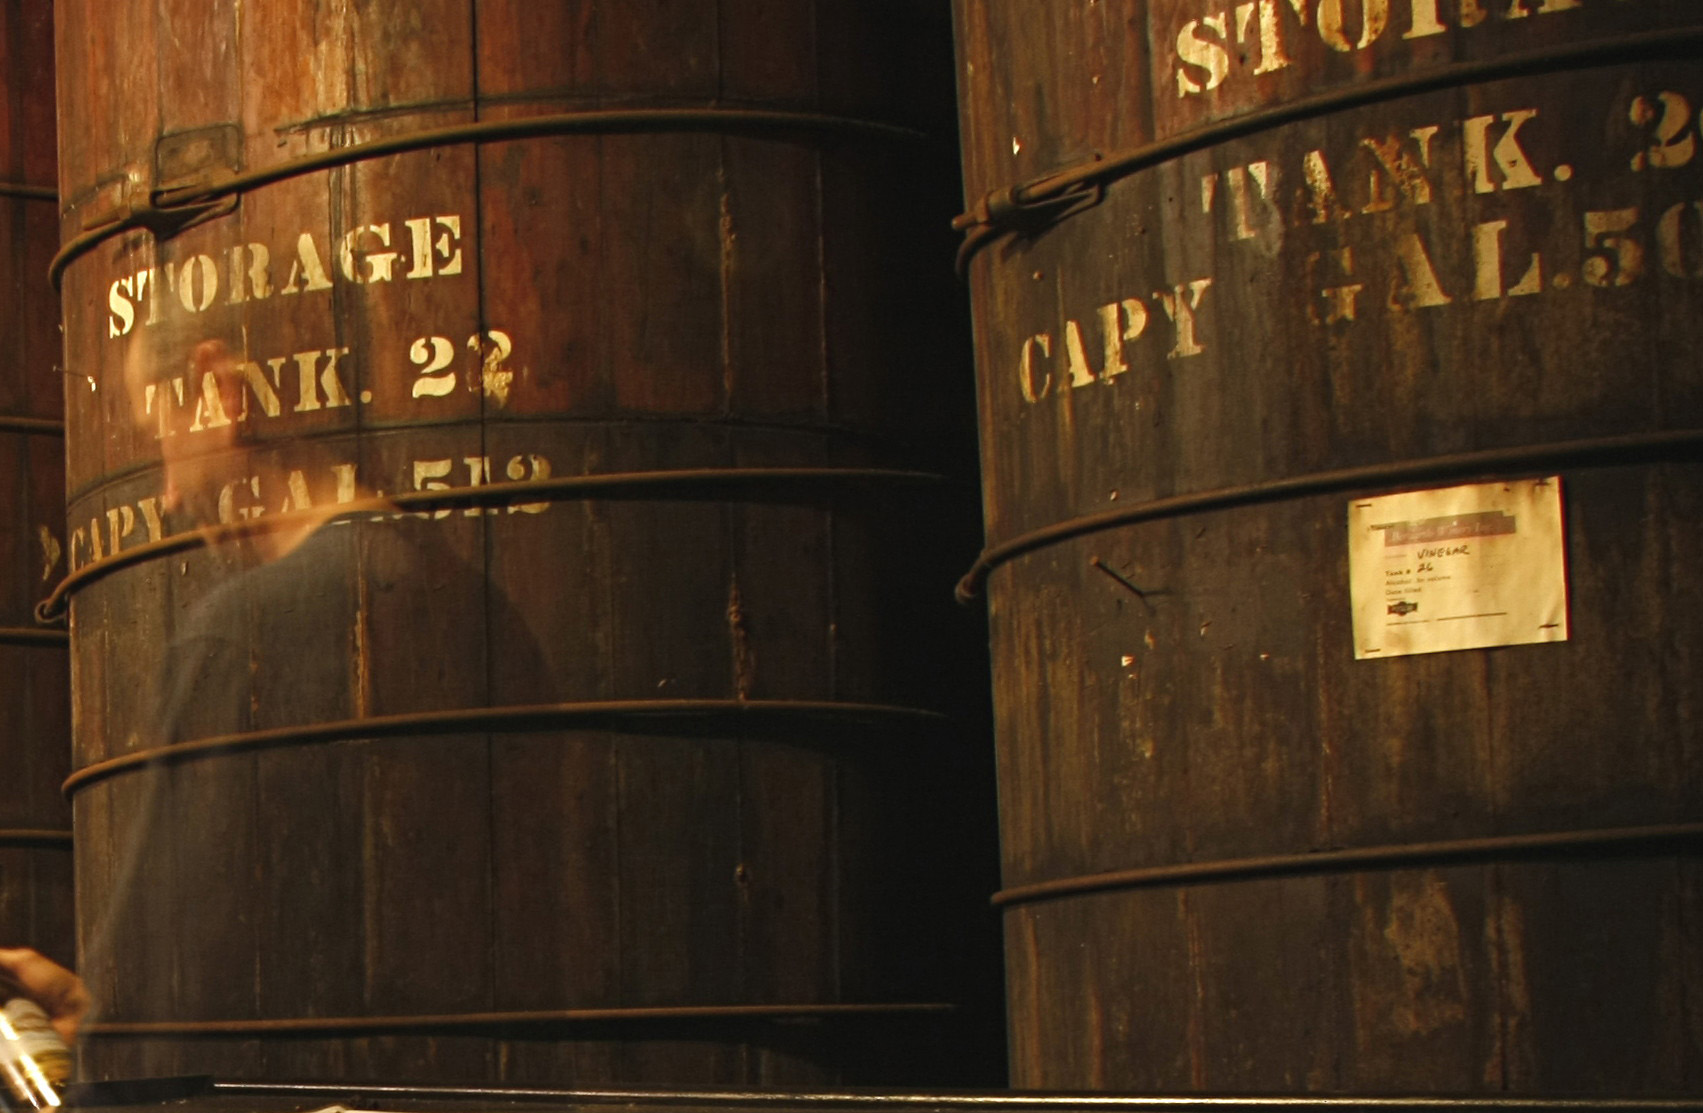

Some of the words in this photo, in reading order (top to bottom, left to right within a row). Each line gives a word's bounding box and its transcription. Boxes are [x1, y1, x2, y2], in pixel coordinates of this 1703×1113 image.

[1175, 0, 1582, 98] STO
[1202, 107, 1573, 241] TANK.
[1629, 89, 1703, 173] 2
[107, 214, 464, 339] STORAGE
[144, 346, 373, 440] TANK.
[1019, 277, 1213, 404] CAPY
